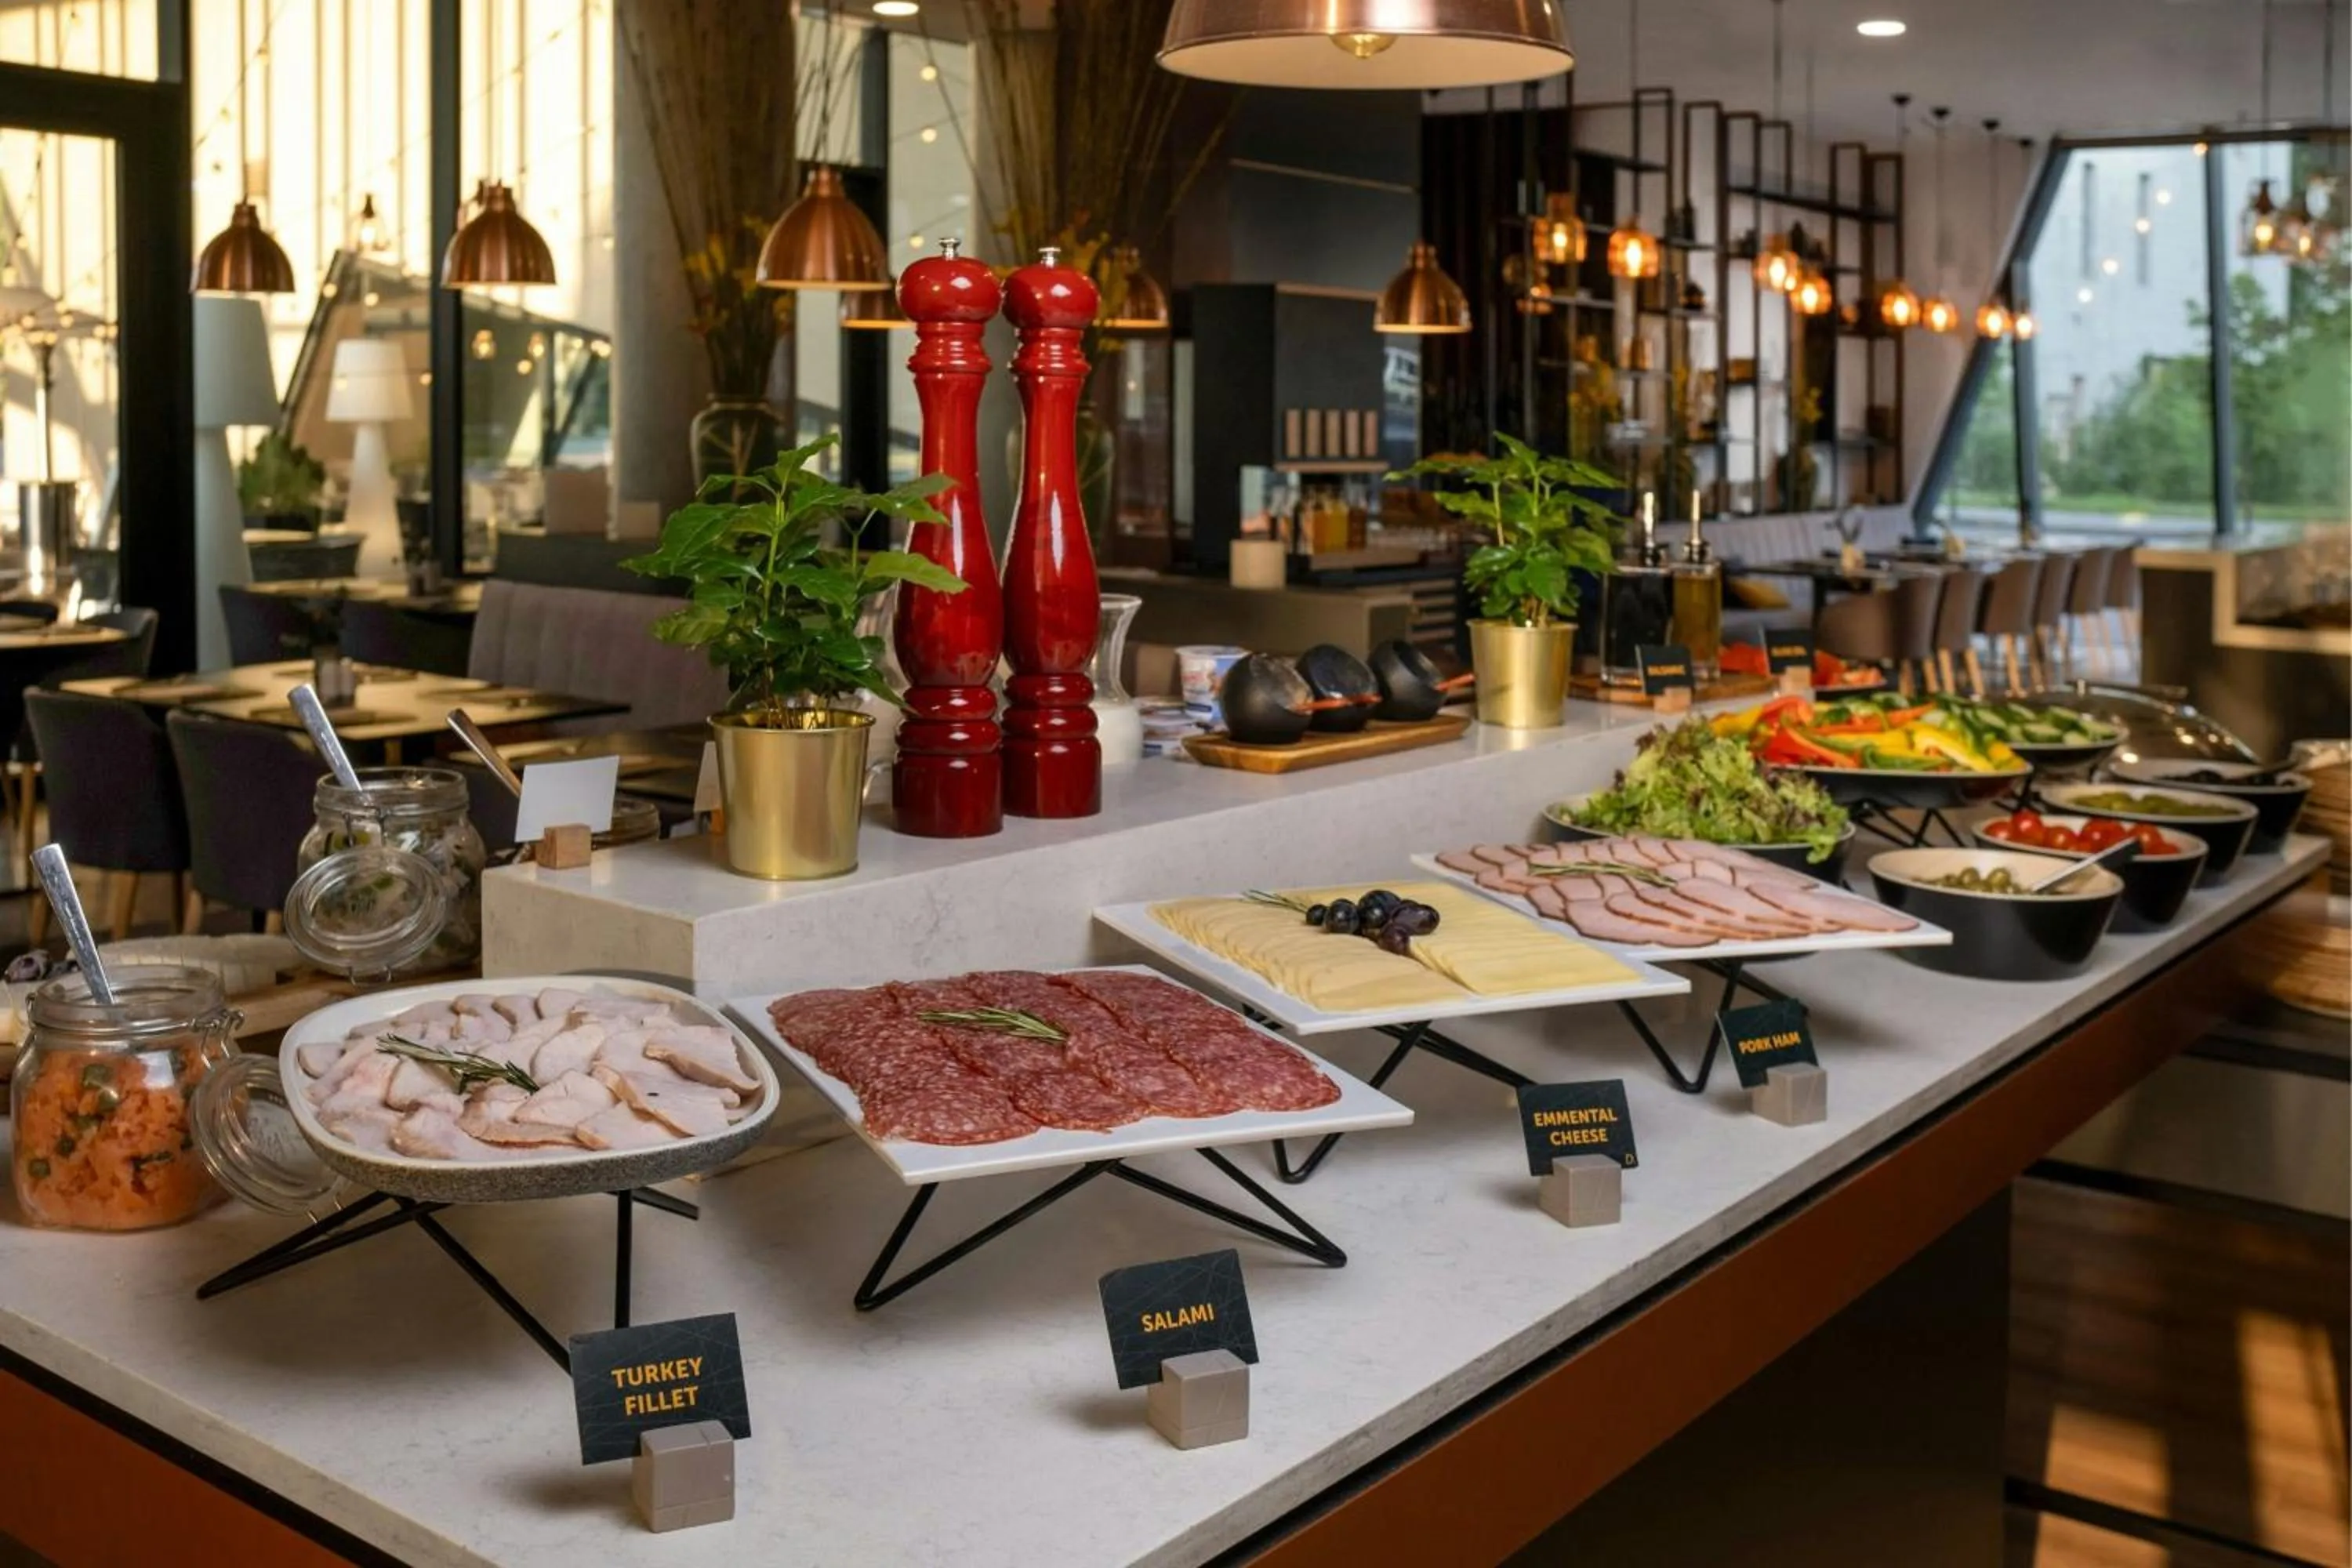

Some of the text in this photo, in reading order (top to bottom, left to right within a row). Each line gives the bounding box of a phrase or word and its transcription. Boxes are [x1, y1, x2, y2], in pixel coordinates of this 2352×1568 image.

[1738, 1031, 1801, 1054] PORK HAM
[1534, 1107, 1618, 1127] EMMENTAL
[1549, 1127, 1609, 1146] CHEESE
[1141, 1303, 1214, 1333] SALAMI
[611, 1356, 702, 1388] TURKEY
[624, 1386, 699, 1416] FILLET
